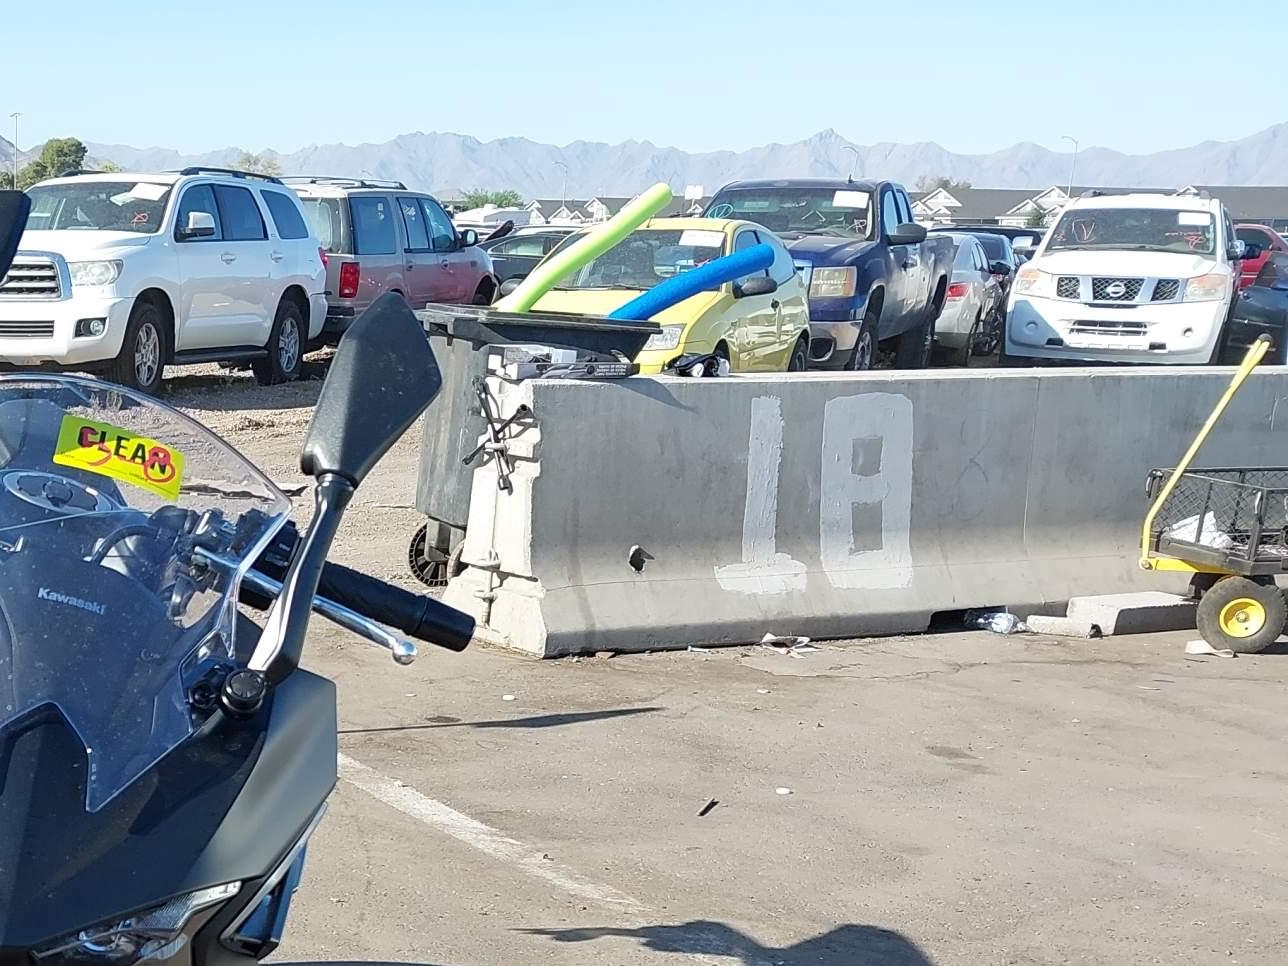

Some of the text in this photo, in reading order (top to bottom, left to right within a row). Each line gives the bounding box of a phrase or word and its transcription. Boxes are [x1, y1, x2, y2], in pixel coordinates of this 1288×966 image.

[78, 426, 168, 475] CLEAN
[714, 391, 913, 595] 18
[37, 587, 105, 615] Kawasaki
